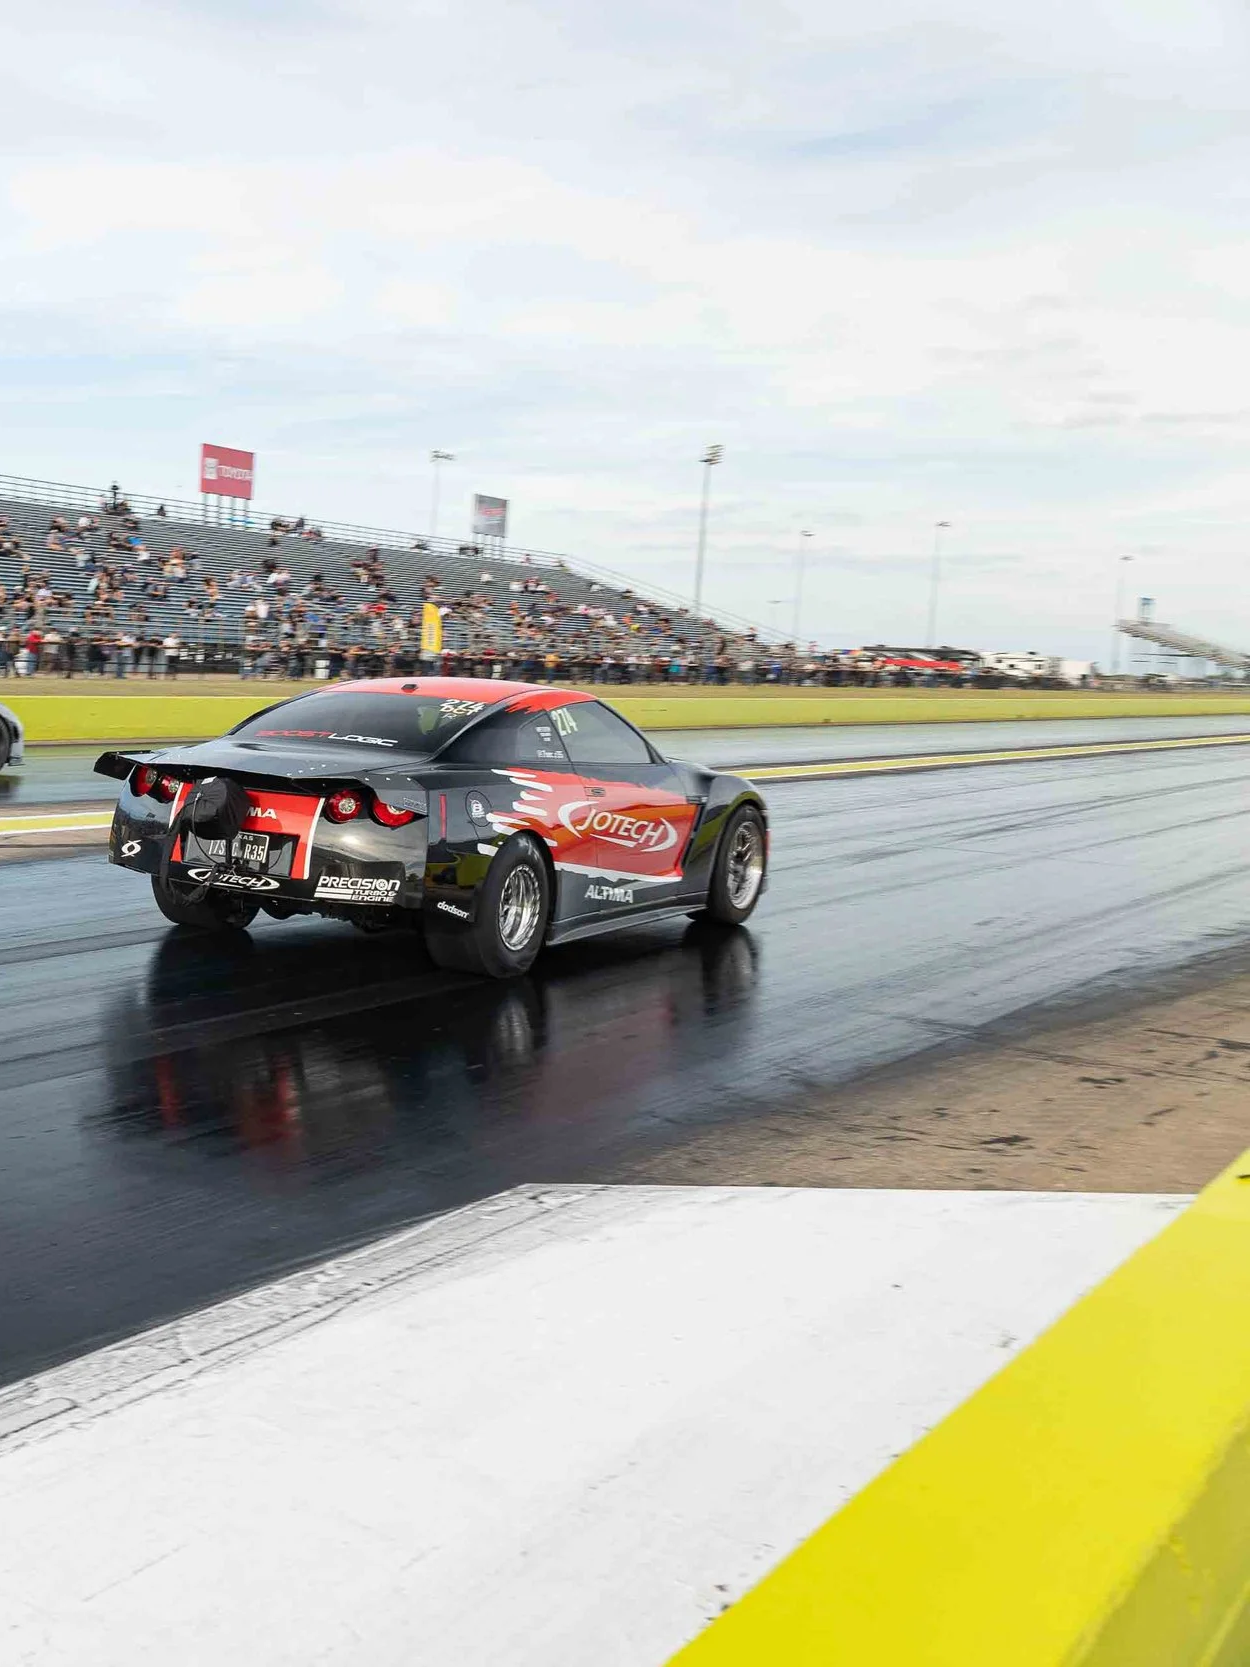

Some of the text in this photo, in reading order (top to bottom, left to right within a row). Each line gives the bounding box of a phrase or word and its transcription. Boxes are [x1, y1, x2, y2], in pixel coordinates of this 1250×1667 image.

[551, 707, 578, 737] 274
[575, 808, 665, 846] JOTECH
[317, 875, 401, 891] PRECISION
[351, 894, 395, 902] ENGINE
[584, 884, 634, 903] ALTIMA
[437, 900, 469, 919] dodson
